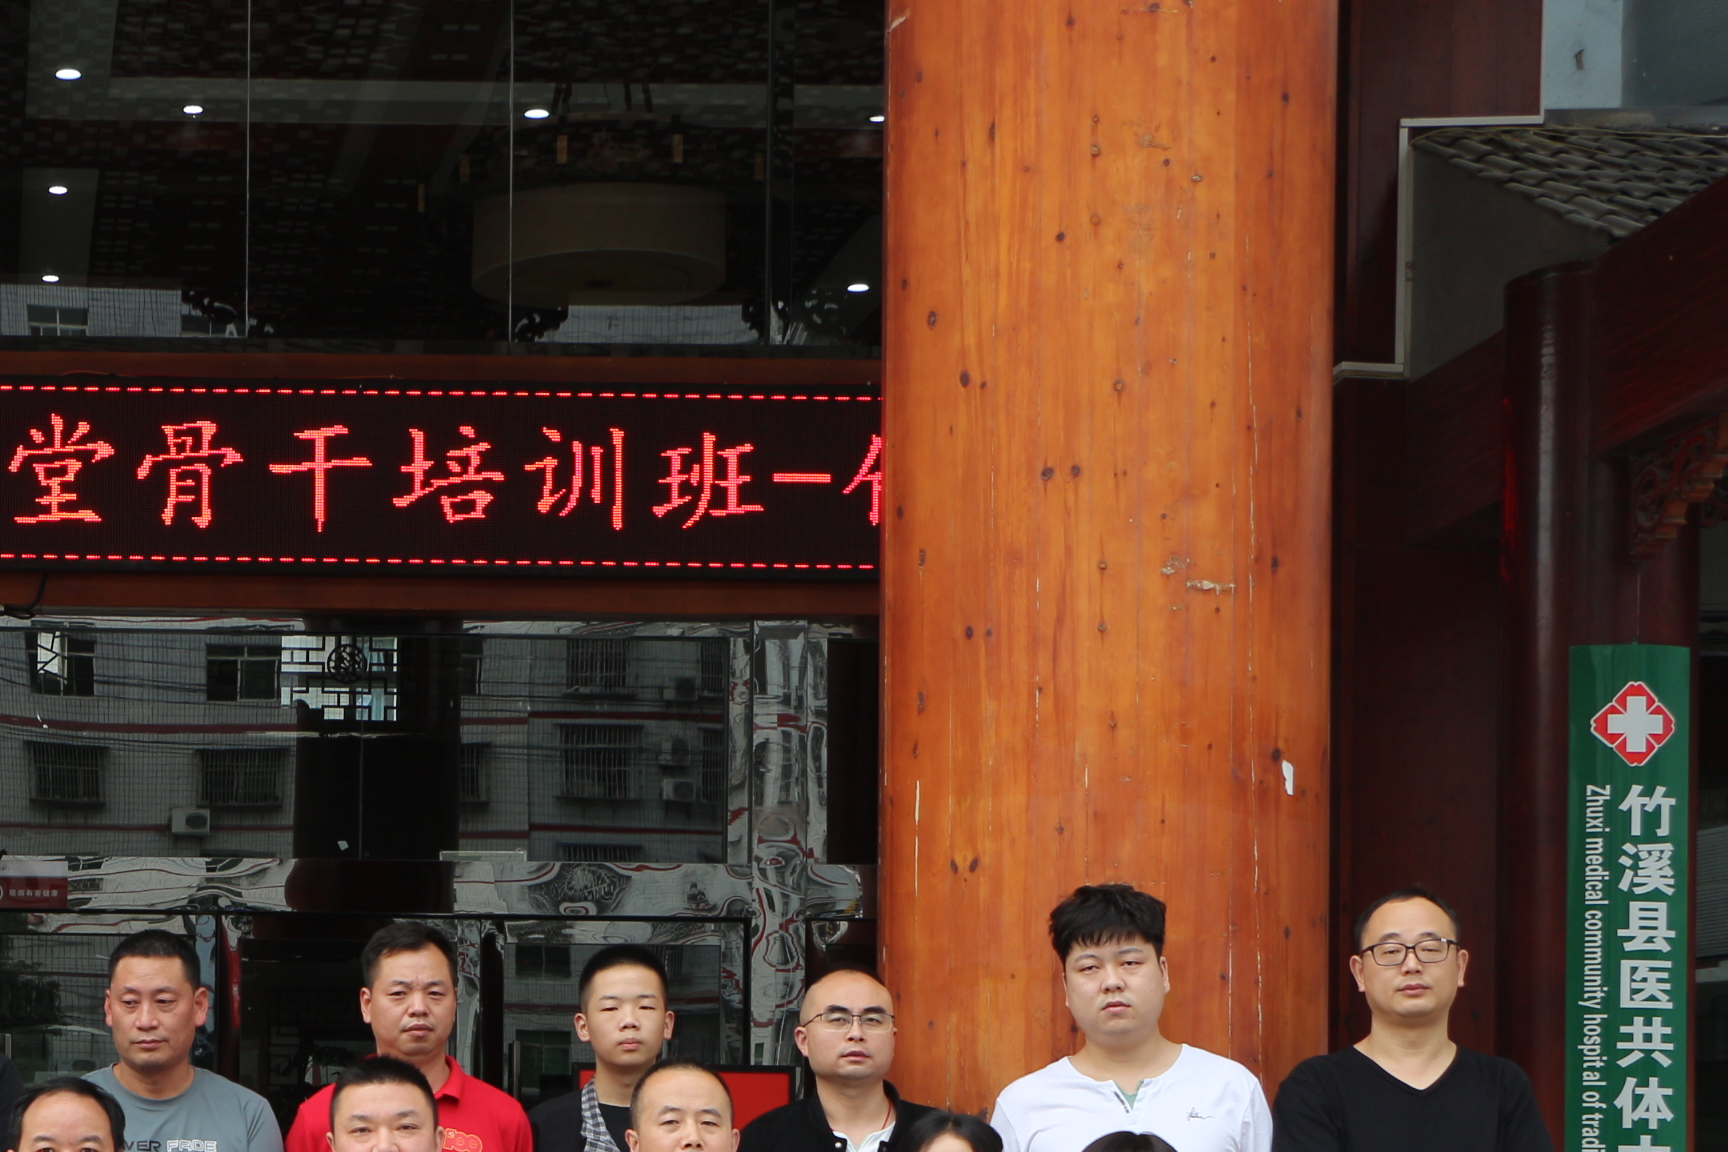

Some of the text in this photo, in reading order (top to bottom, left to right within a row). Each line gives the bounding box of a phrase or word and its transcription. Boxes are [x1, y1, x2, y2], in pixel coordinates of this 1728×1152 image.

[1585, 784, 1611, 833] Zhuxi
[1584, 837, 1609, 904] medical
[1578, 909, 1608, 1009] community
[1582, 1090, 1607, 1108] of
[166, 1139, 217, 1152] FADE
